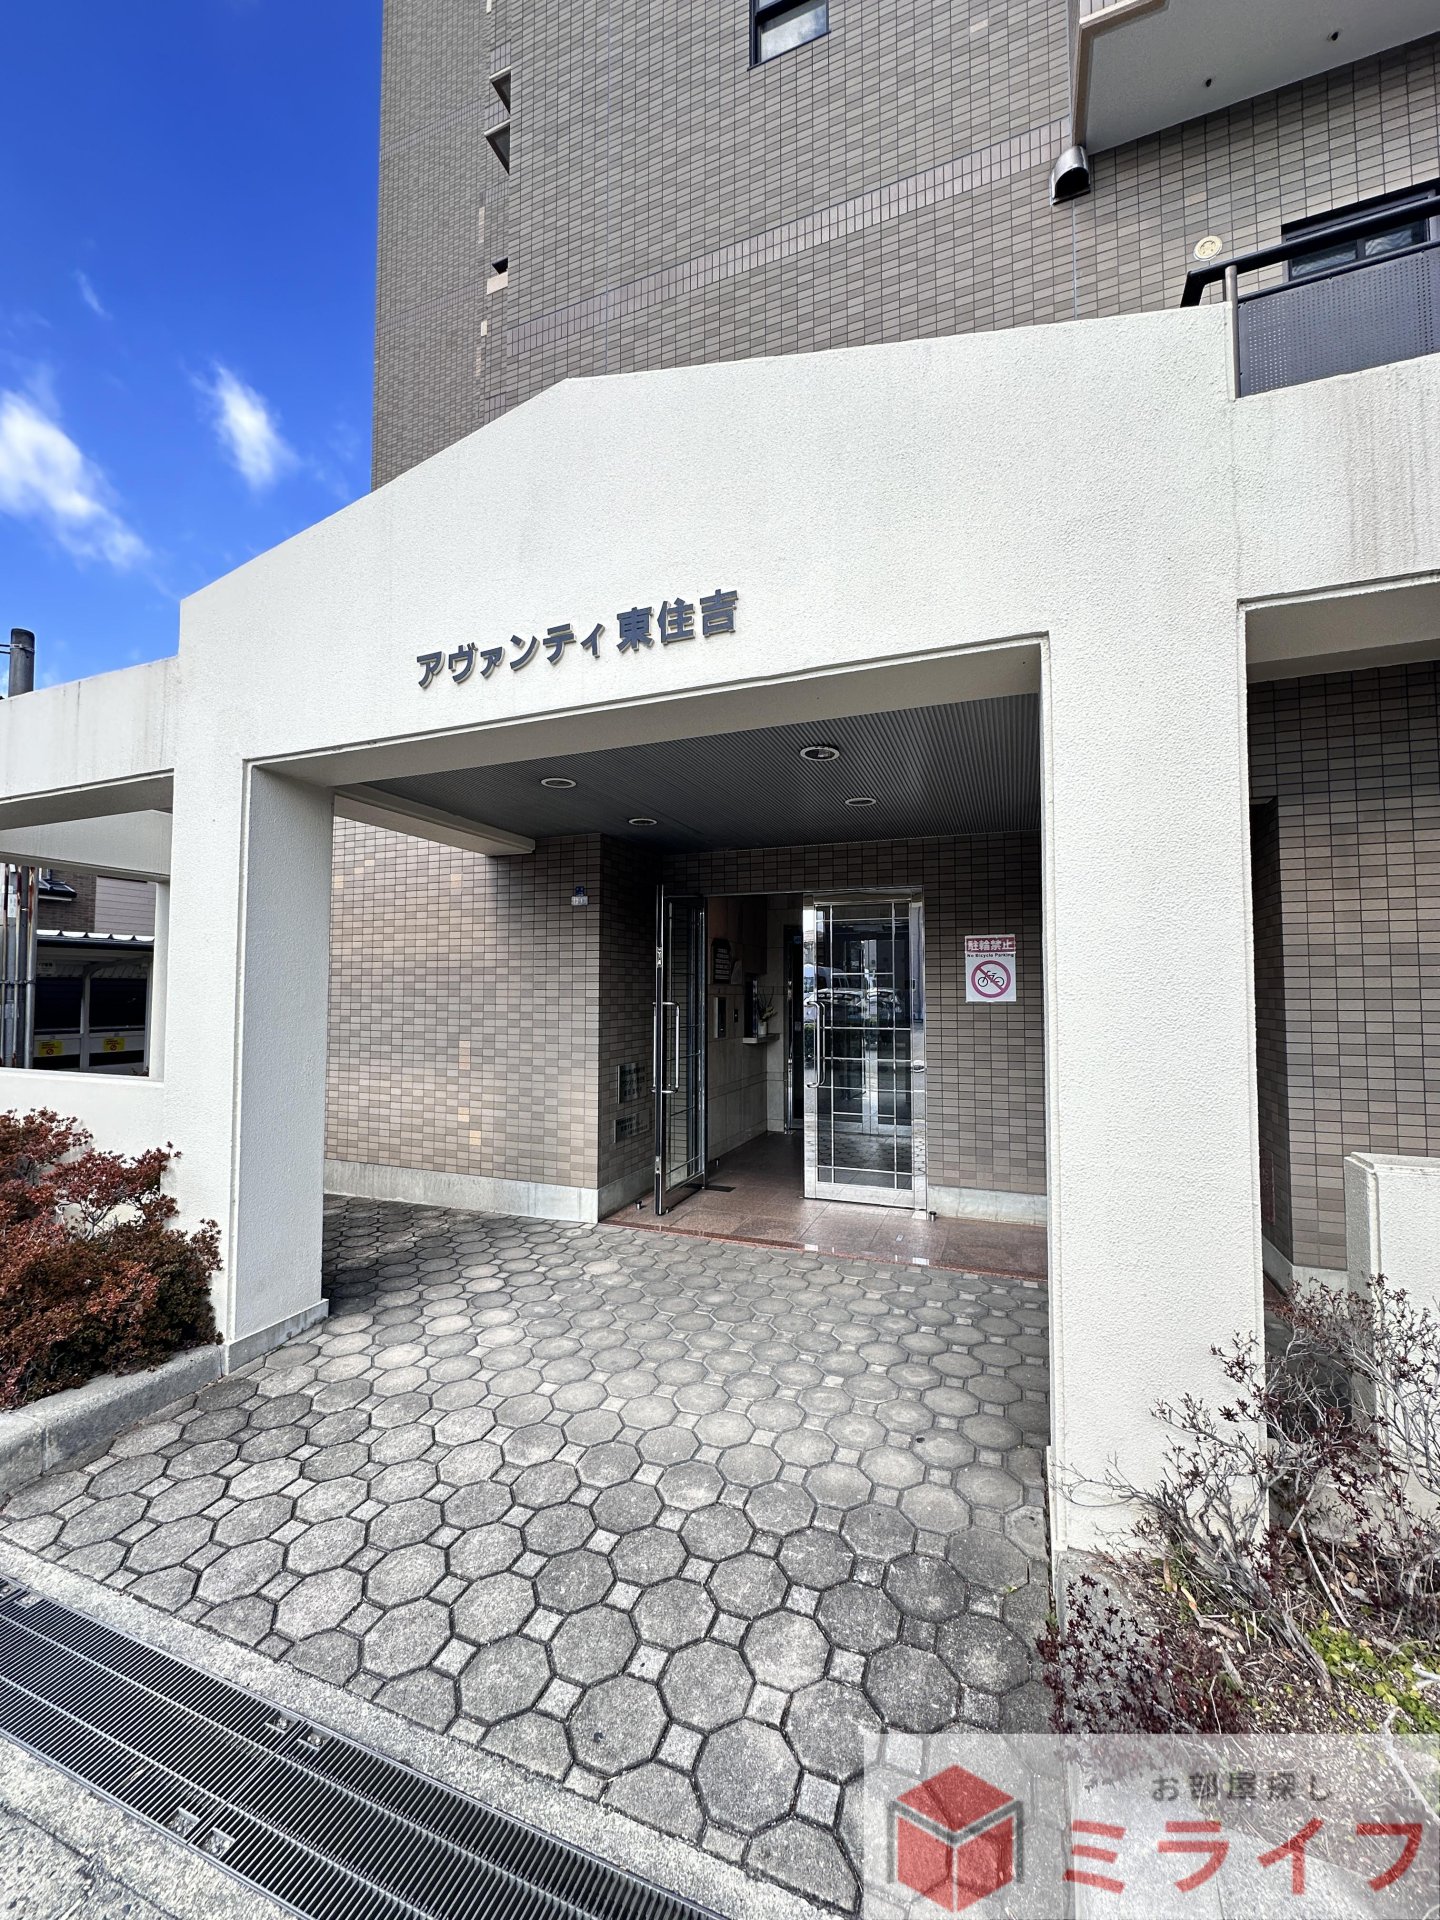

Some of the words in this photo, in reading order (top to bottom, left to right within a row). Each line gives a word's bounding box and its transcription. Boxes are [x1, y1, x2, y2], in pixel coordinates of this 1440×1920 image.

[416, 588, 740, 689] アヴァンティ東住吉
[967, 939, 1015, 950] 駐輪禁止
